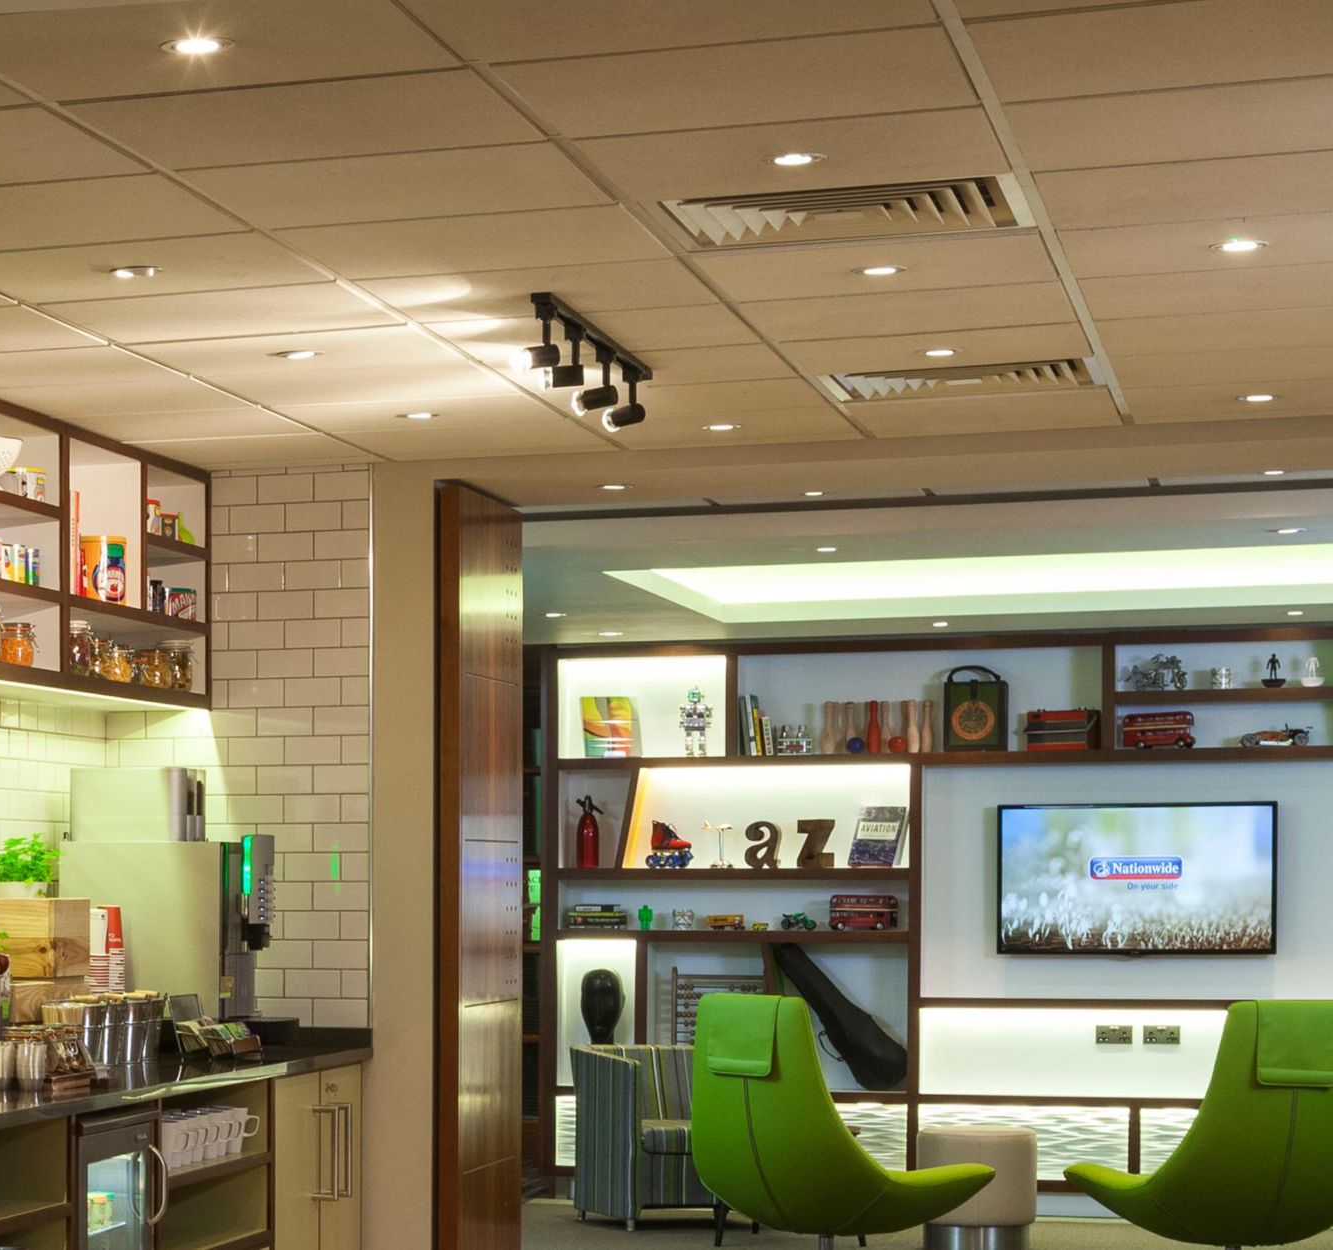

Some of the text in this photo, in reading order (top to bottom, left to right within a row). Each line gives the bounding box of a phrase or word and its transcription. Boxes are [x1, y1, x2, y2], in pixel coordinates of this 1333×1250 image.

[860, 823, 898, 833] AVIATION
[1112, 862, 1179, 874] Nationwide
[1127, 882, 1179, 892] On your side
